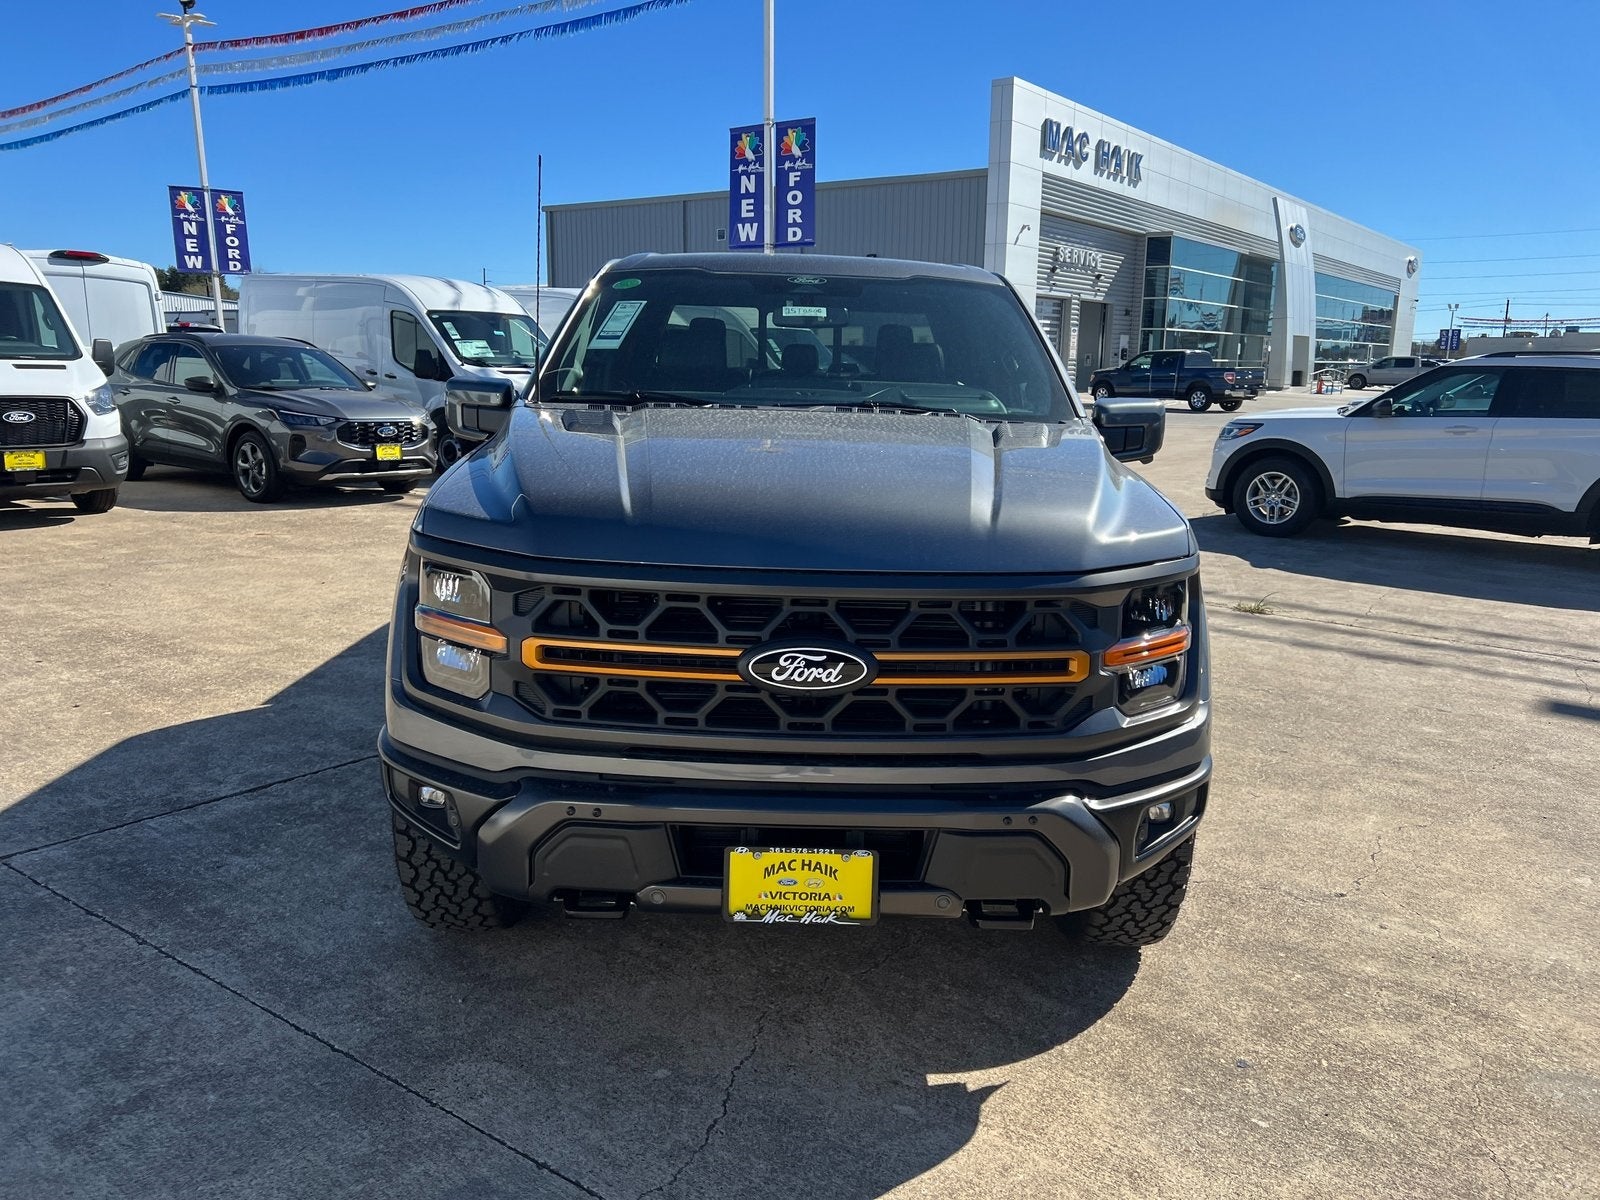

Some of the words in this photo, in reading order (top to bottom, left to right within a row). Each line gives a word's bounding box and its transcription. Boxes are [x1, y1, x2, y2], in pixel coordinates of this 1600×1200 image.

[1041, 118, 1090, 163] MAC
[1097, 138, 1144, 181] HAIK
[737, 174, 759, 242] NEW
[786, 172, 803, 242] FORD
[183, 221, 203, 269] NEW
[225, 223, 242, 271] FORD
[1058, 246, 1103, 268] SERVICE
[771, 653, 845, 683] Ford
[763, 859, 797, 880] MAC
[801, 859, 839, 881] HAIK
[745, 903, 855, 913] MACHAIKVICTORIA.COM
[769, 891, 832, 901] VICTORIA
[761, 909, 797, 924] Mac
[800, 910, 840, 925] Haik
